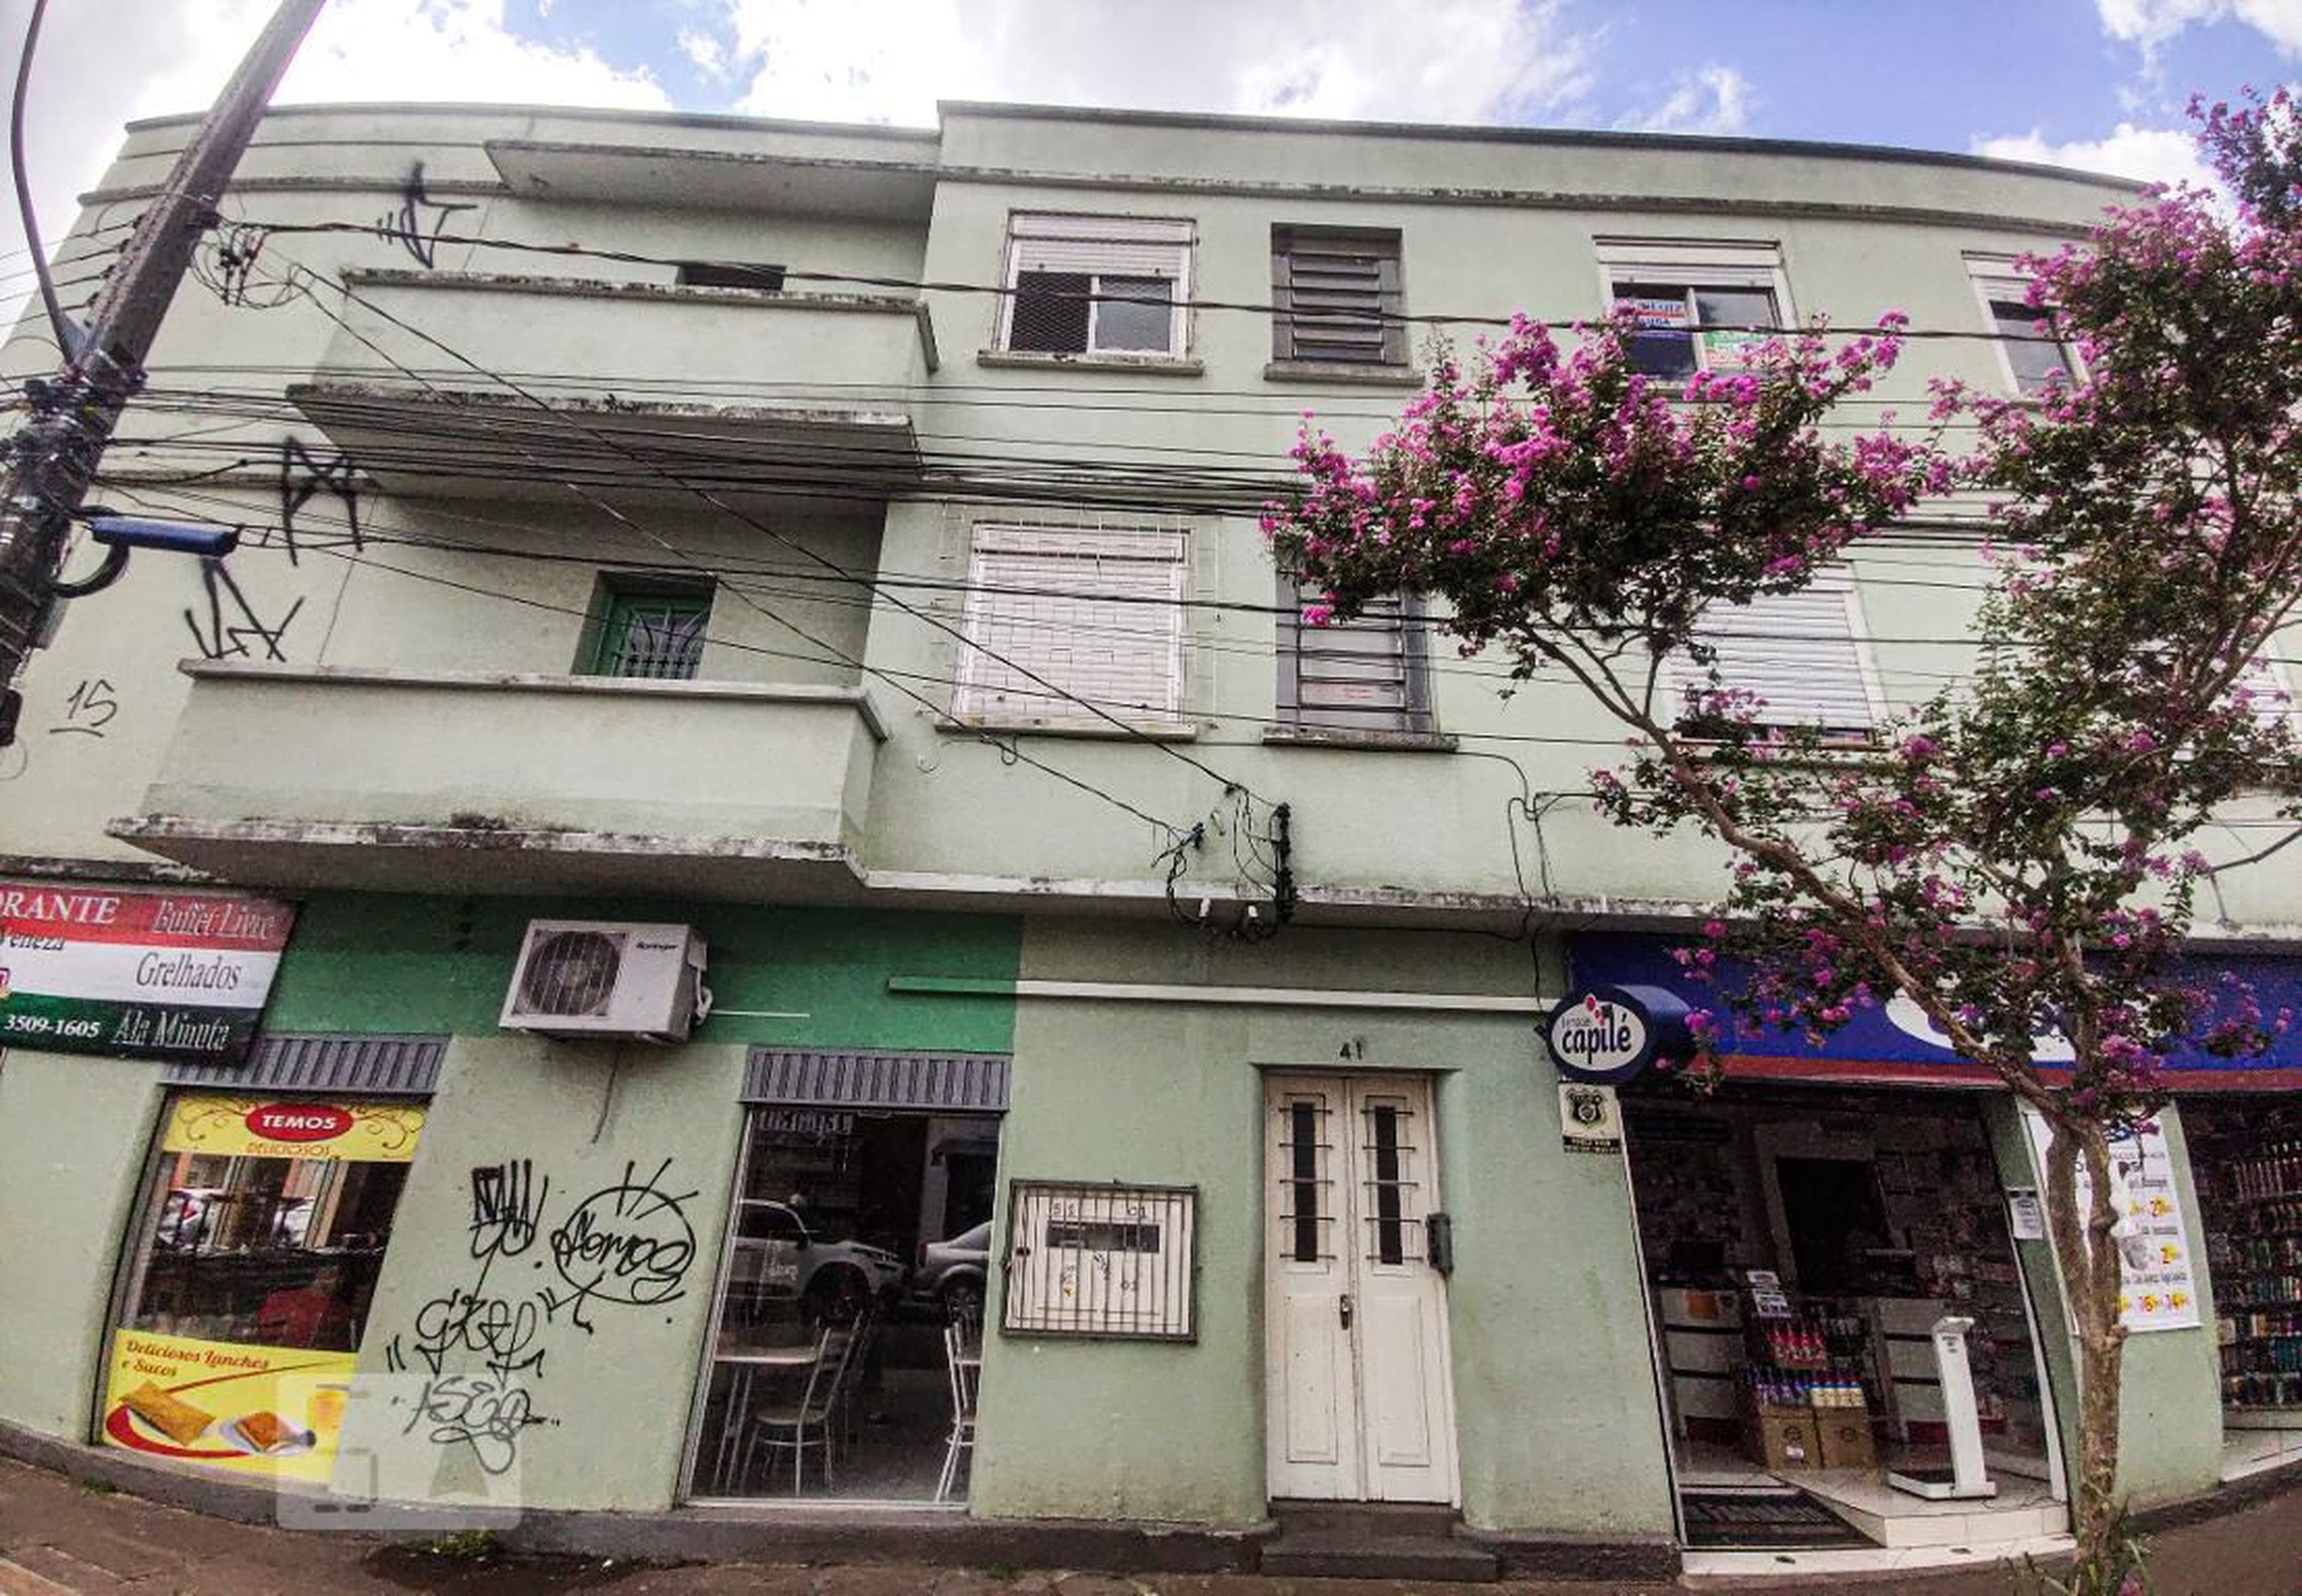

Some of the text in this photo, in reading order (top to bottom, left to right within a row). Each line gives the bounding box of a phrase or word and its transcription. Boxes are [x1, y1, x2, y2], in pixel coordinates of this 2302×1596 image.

[136, 951, 242, 990] Grelhados
[4, 1013, 101, 1038] 3509-1605
[152, 1011, 230, 1050] Minuta
[1562, 1004, 1632, 1065] capilé
[1339, 1041, 1362, 1061] 41
[262, 1115, 338, 1130] TEMOS
[122, 1358, 178, 1378] e Sucos
[126, 1339, 269, 1371] Deliciosos Lanches
